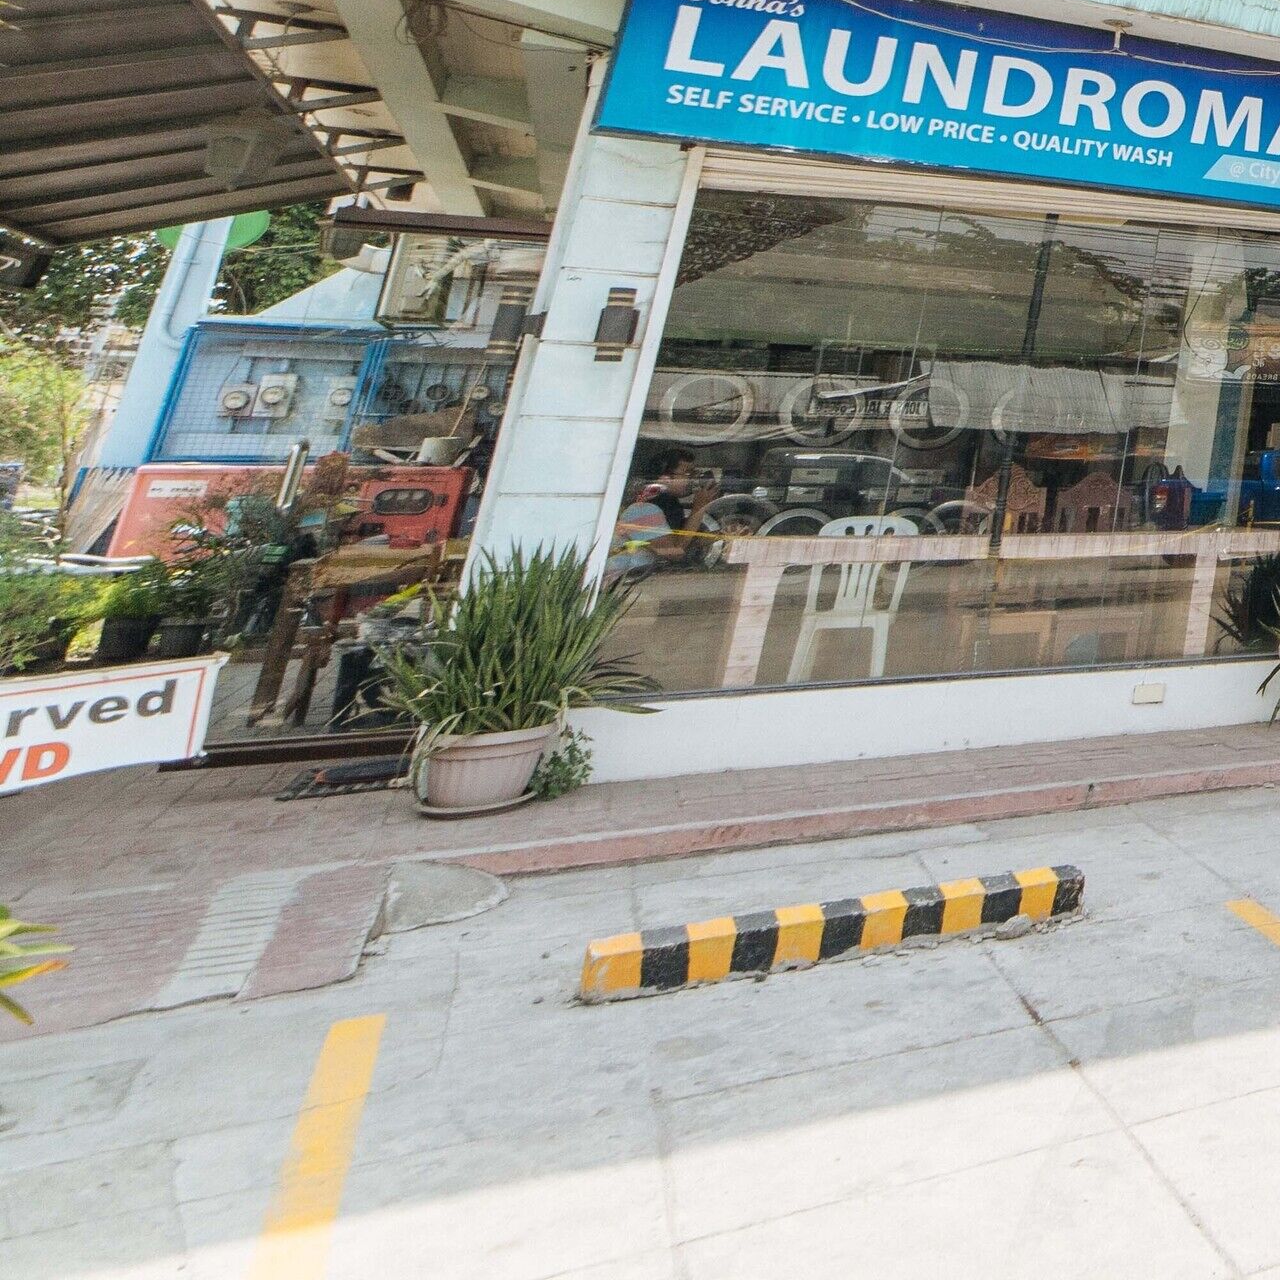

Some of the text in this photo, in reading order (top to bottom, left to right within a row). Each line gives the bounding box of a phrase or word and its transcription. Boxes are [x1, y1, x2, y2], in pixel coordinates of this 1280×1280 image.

[665, 84, 1173, 168] SELF SERVICE LOW PRICE QUALITY WASH
